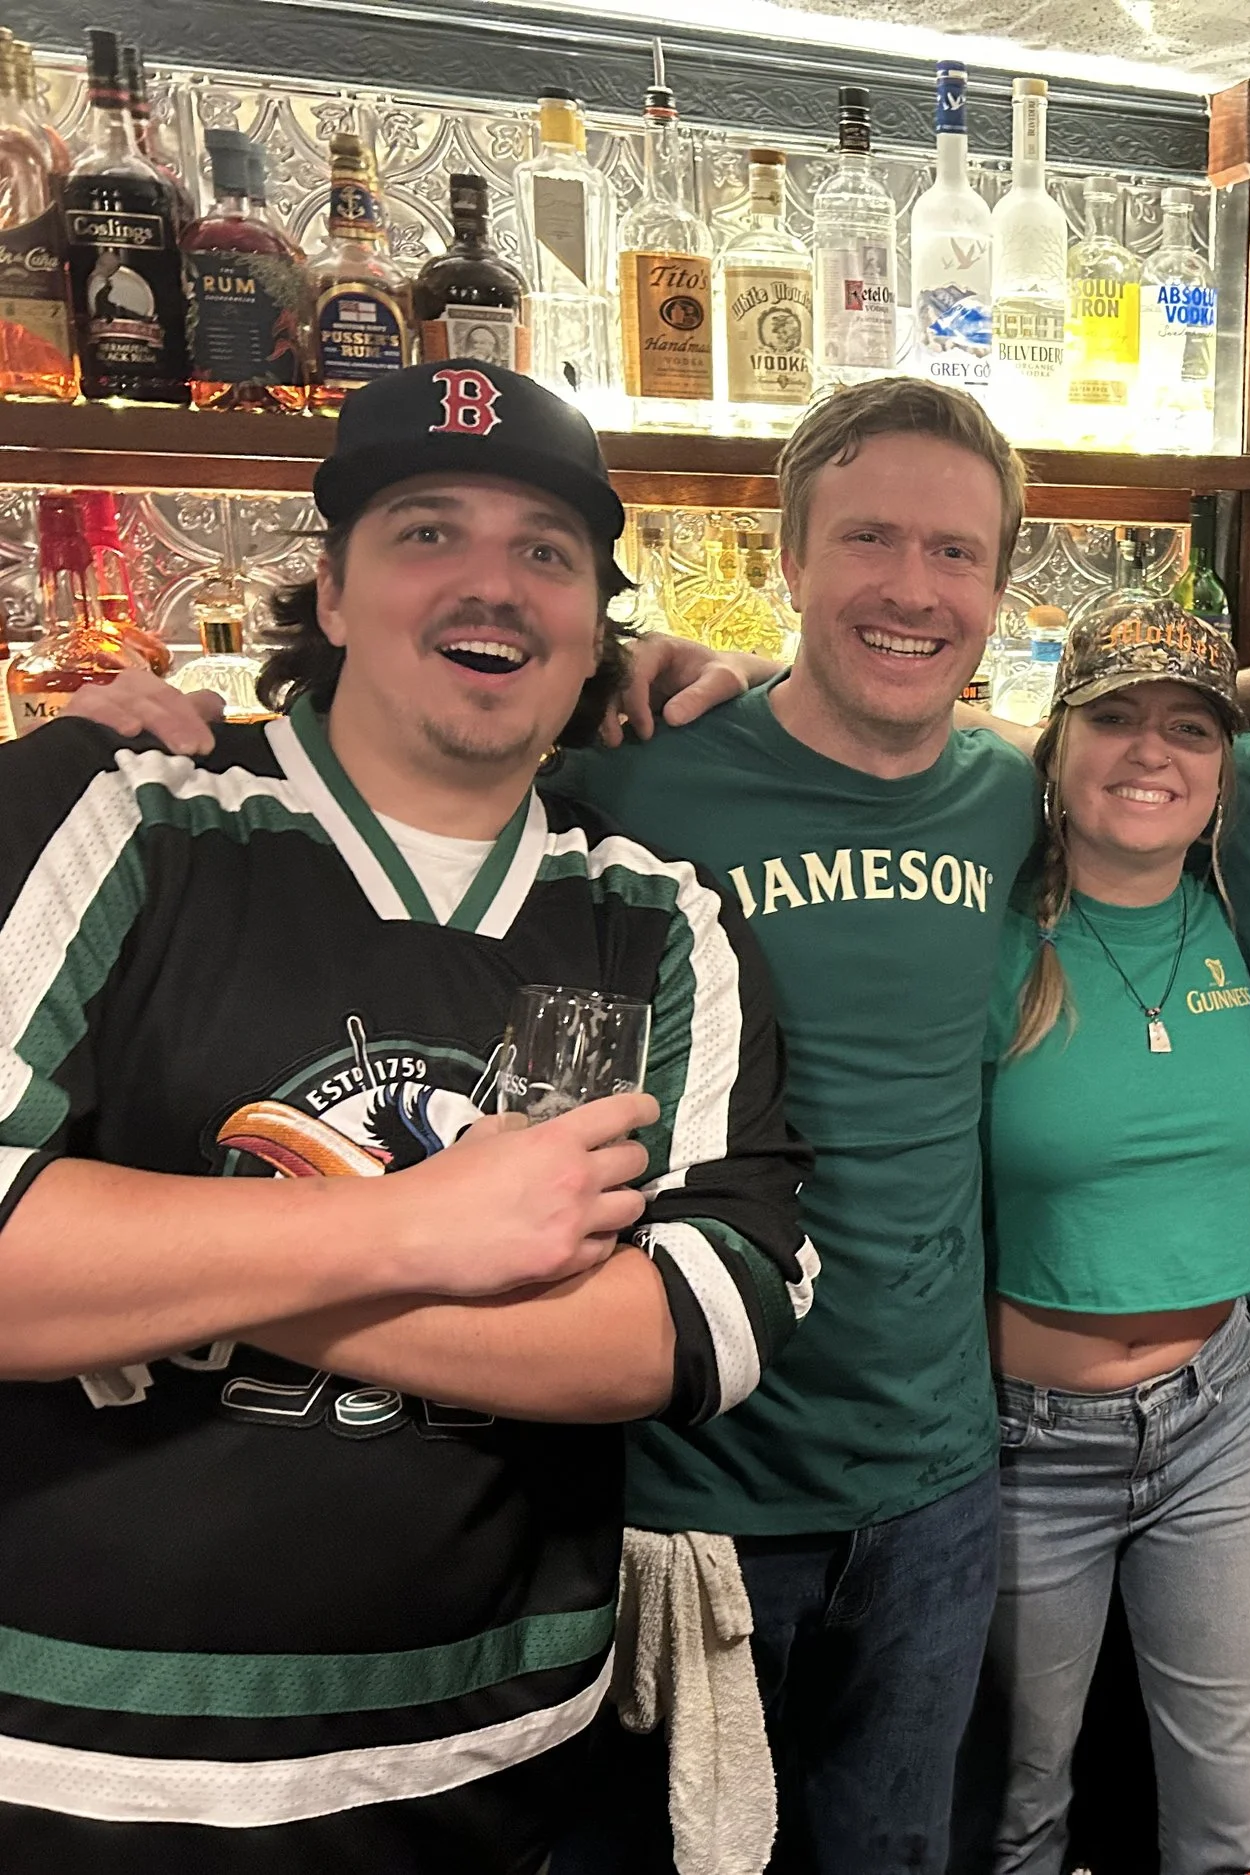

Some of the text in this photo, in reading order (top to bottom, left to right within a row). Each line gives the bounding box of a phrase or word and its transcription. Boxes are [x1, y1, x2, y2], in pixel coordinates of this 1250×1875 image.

[203, 275, 256, 294] RUM
[651, 265, 708, 290] Tito's
[731, 286, 769, 321] White
[1157, 285, 1219, 307] ABSOLU
[341, 345, 380, 358] RUM
[751, 354, 809, 373] VODKA
[930, 361, 991, 378] GREY GO
[430, 370, 502, 435] B
[1101, 618, 1221, 669] Mother
[728, 847, 988, 920] JAMESON
[374, 1057, 427, 1081] 1759
